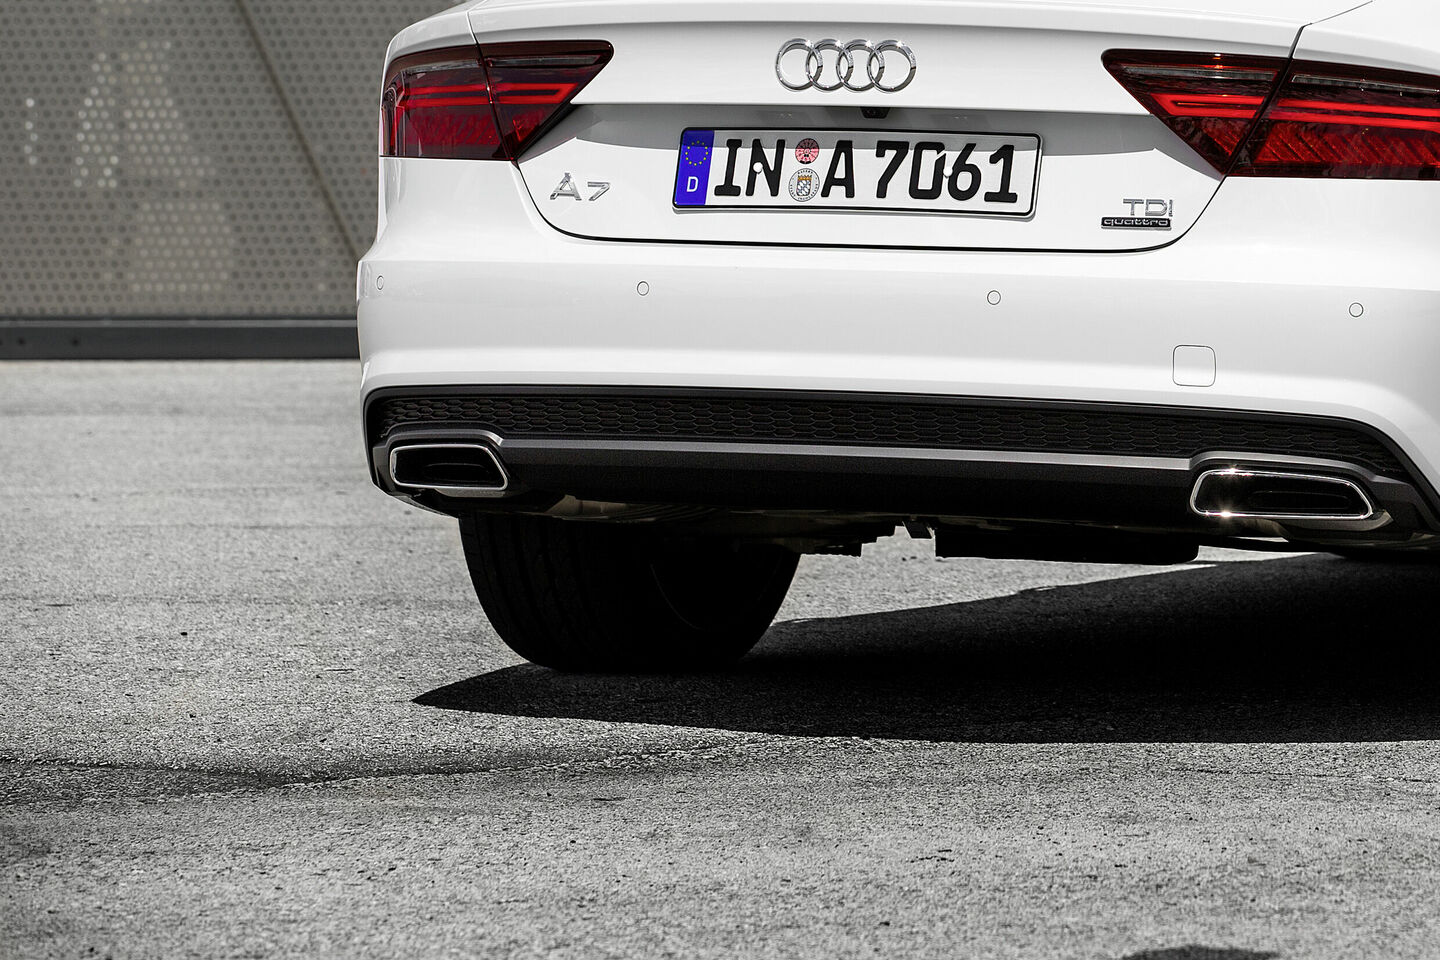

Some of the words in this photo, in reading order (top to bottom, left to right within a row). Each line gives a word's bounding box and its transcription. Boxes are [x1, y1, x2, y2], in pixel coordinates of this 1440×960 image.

[714, 138, 786, 197] IN
[820, 139, 856, 199] A
[875, 140, 1018, 203] 7061
[549, 172, 611, 201] A7
[686, 176, 699, 193] D
[1122, 198, 1174, 217] TDI
[1103, 218, 1169, 227] quattro
